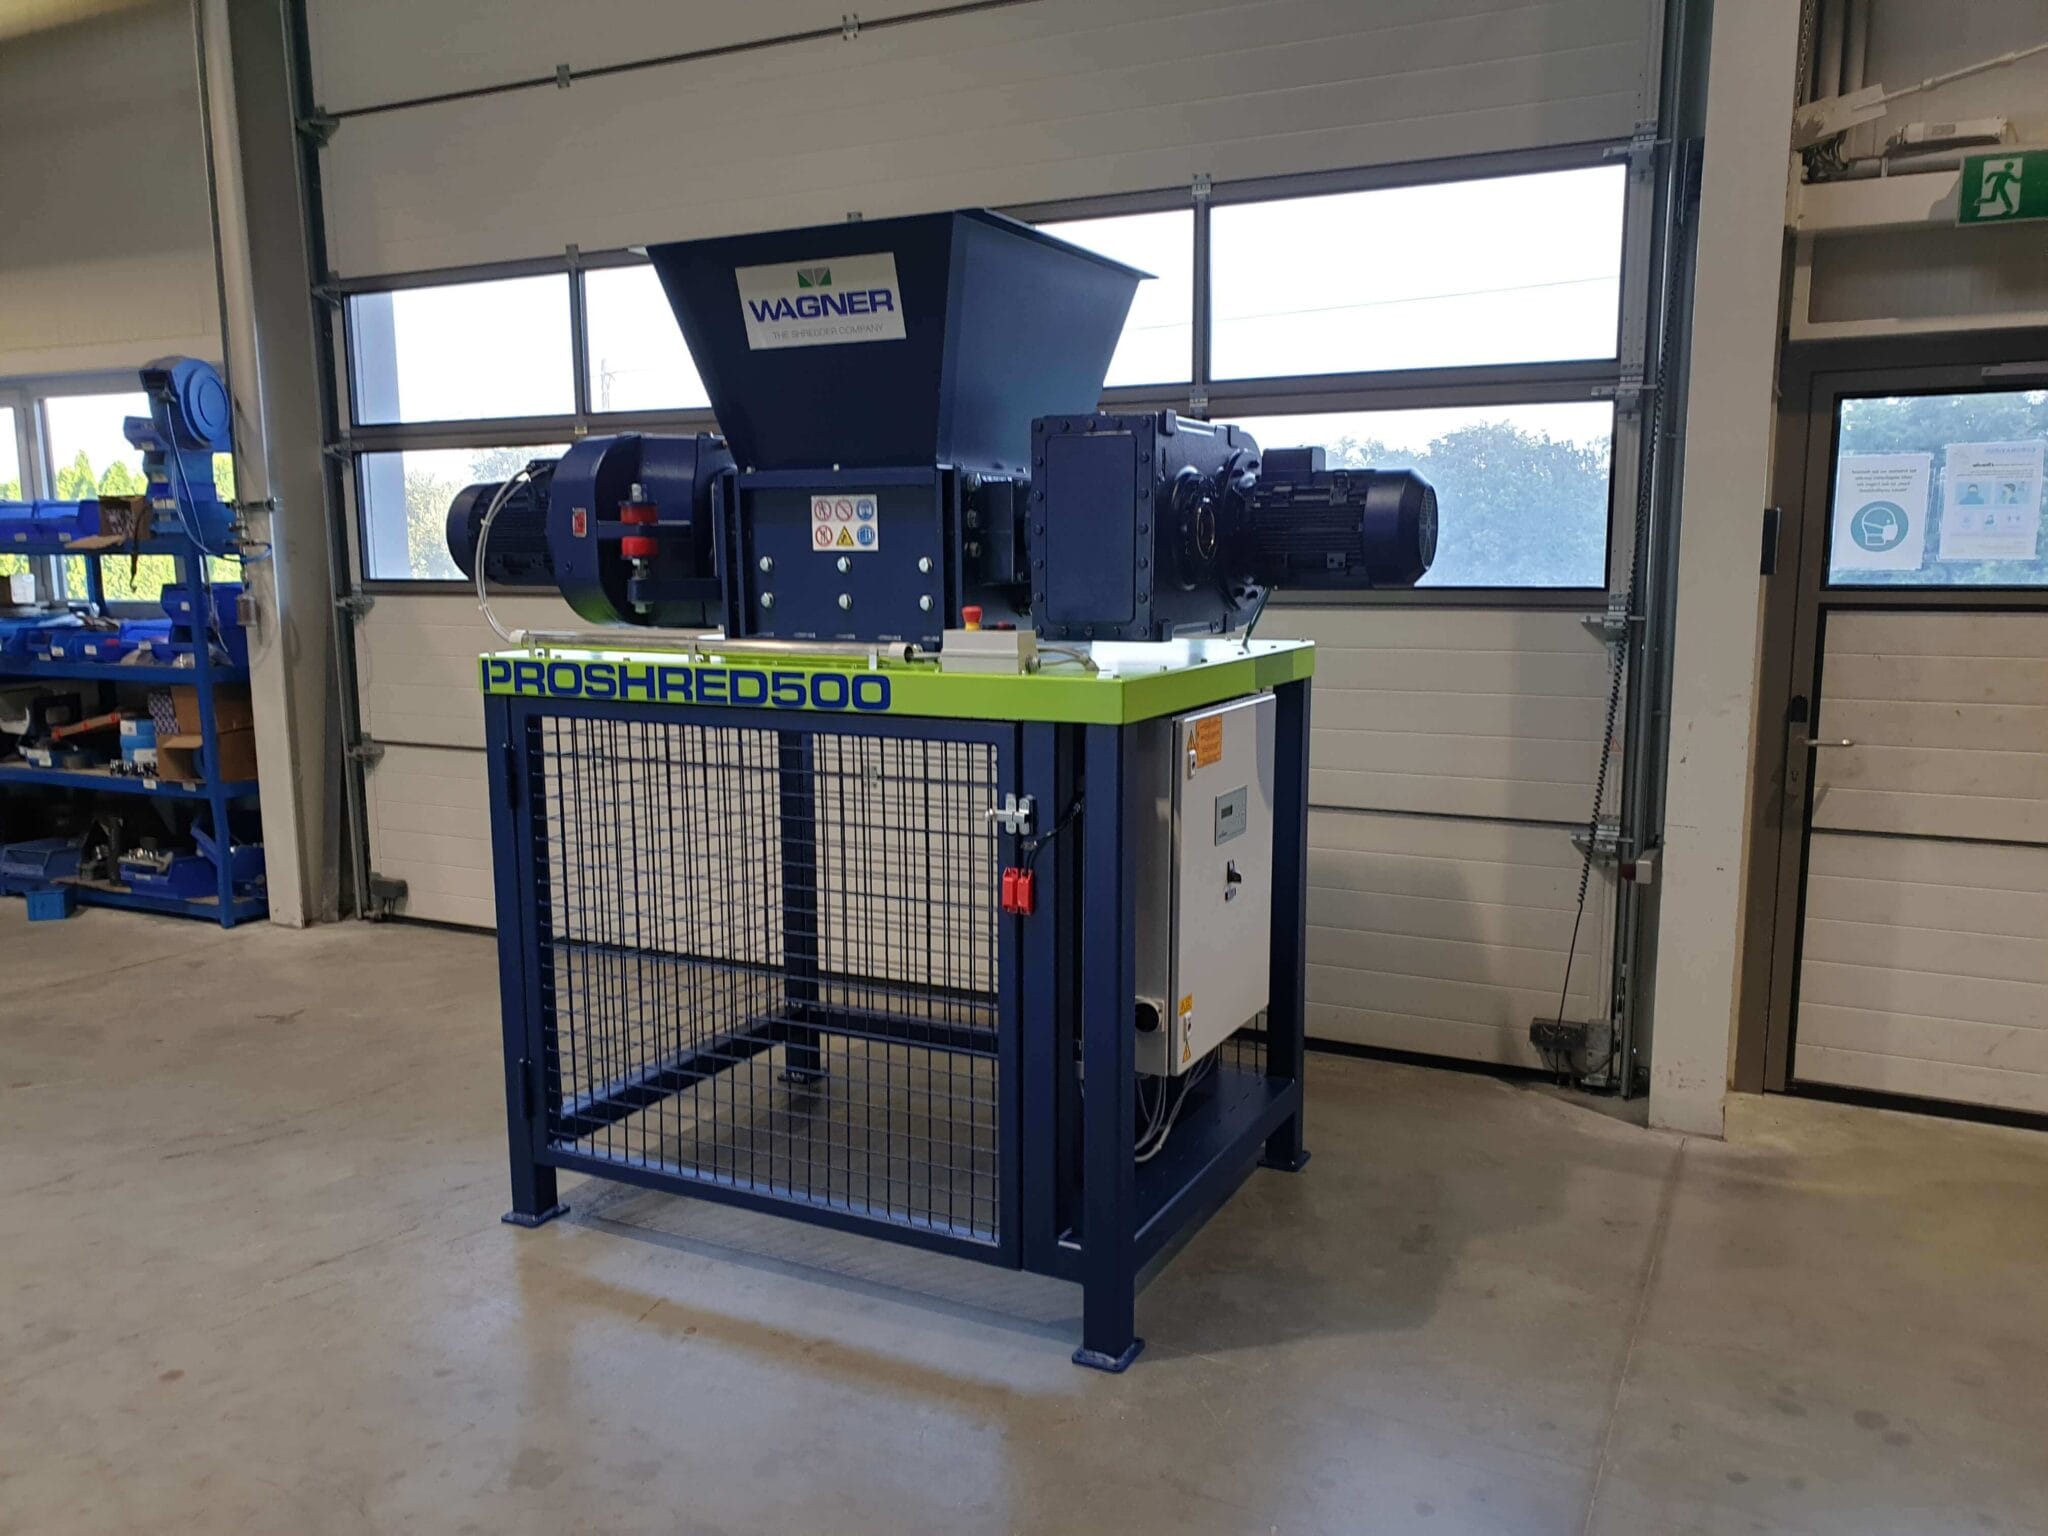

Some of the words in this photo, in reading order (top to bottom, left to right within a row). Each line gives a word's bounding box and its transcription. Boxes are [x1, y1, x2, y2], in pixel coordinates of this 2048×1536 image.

[748, 288, 894, 322] WAGNER
[772, 330, 789, 340] THE
[791, 328, 837, 339] SHREDDER
[839, 323, 884, 335] COMPANY
[482, 659, 892, 711] PROSHRED500
